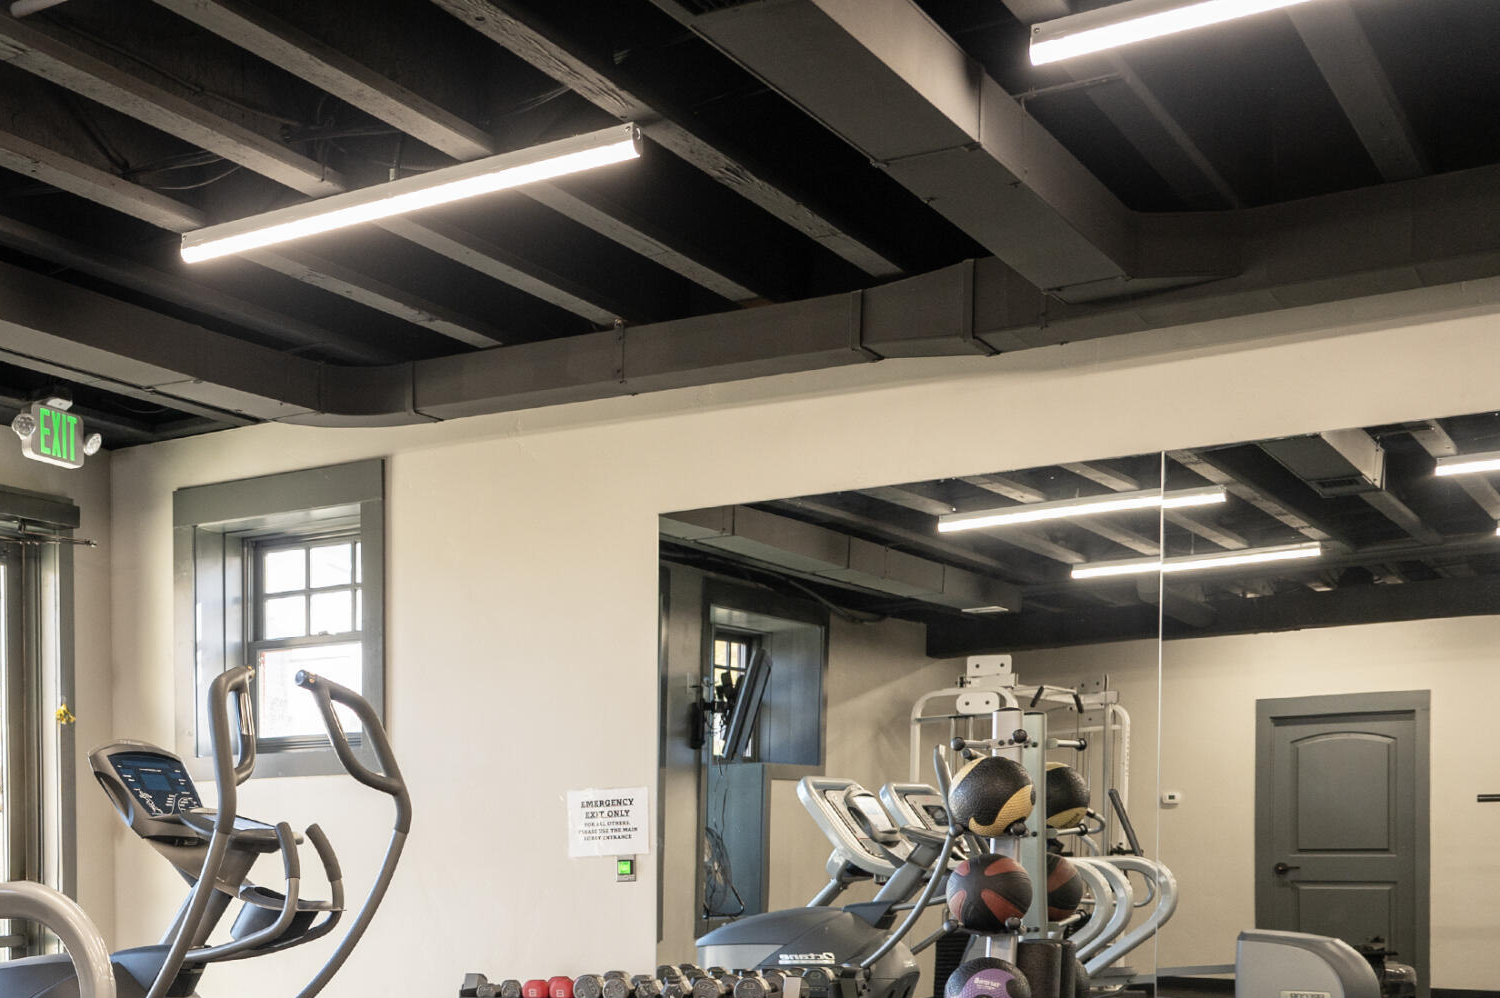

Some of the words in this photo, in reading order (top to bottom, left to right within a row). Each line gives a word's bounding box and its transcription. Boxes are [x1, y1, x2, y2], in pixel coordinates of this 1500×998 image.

[40, 407, 78, 462] EXIT
[581, 798, 634, 808] EMERGENCY
[585, 810, 604, 819] EXIT
[607, 809, 630, 818] ONLY
